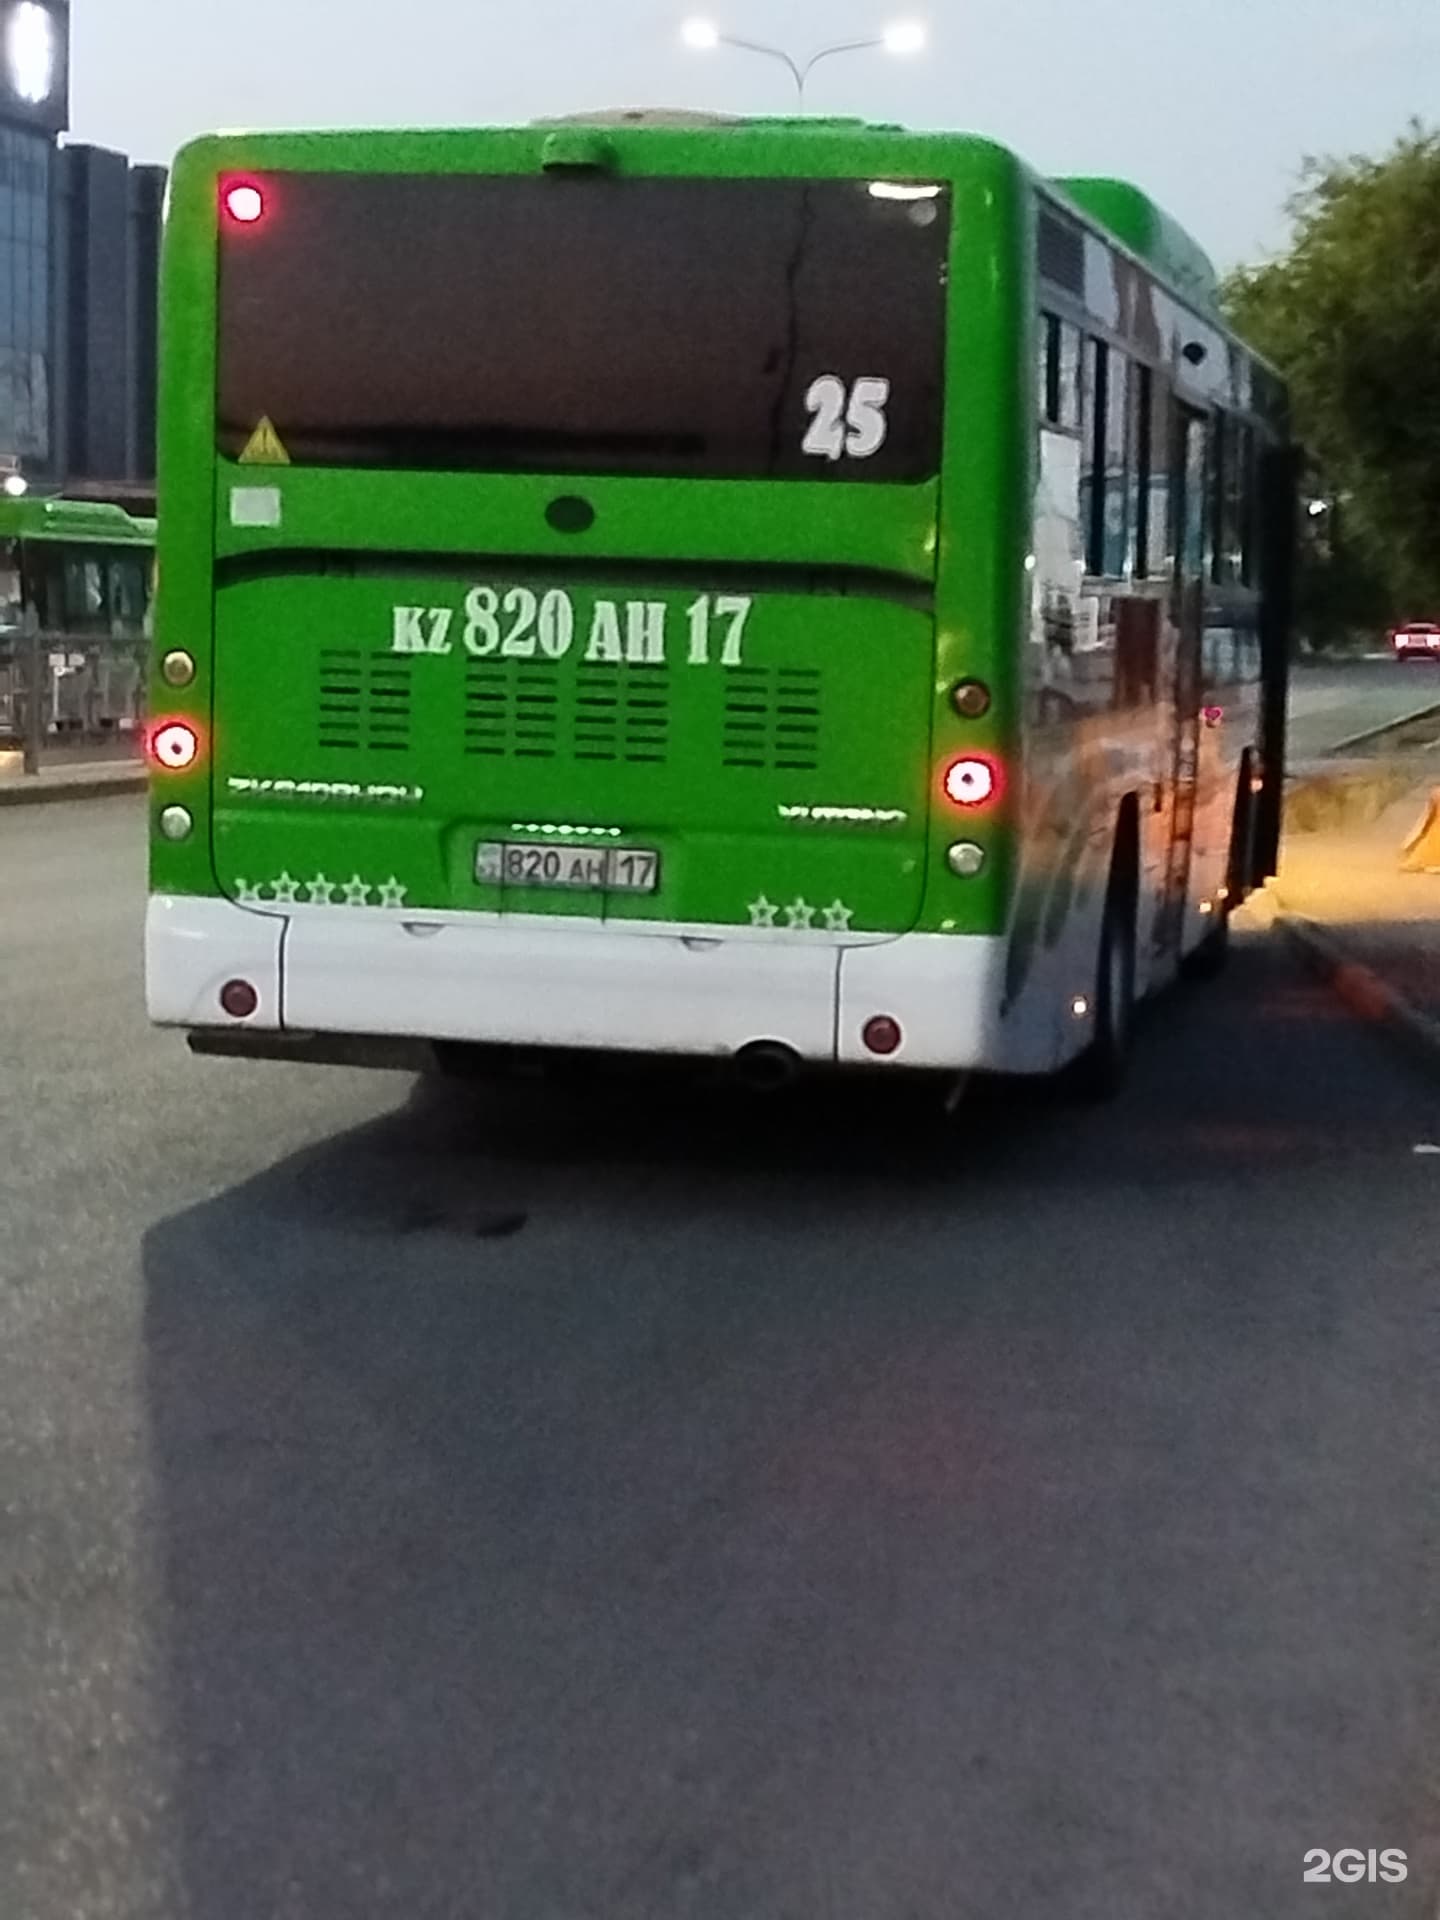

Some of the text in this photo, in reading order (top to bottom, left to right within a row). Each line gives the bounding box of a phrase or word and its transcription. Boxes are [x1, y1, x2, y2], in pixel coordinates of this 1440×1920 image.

[803, 375, 890, 460] 25
[392, 587, 752, 664] KZ 820 AH 17
[508, 849, 561, 880] 820
[570, 858, 607, 882] AH
[620, 855, 654, 884] 17
